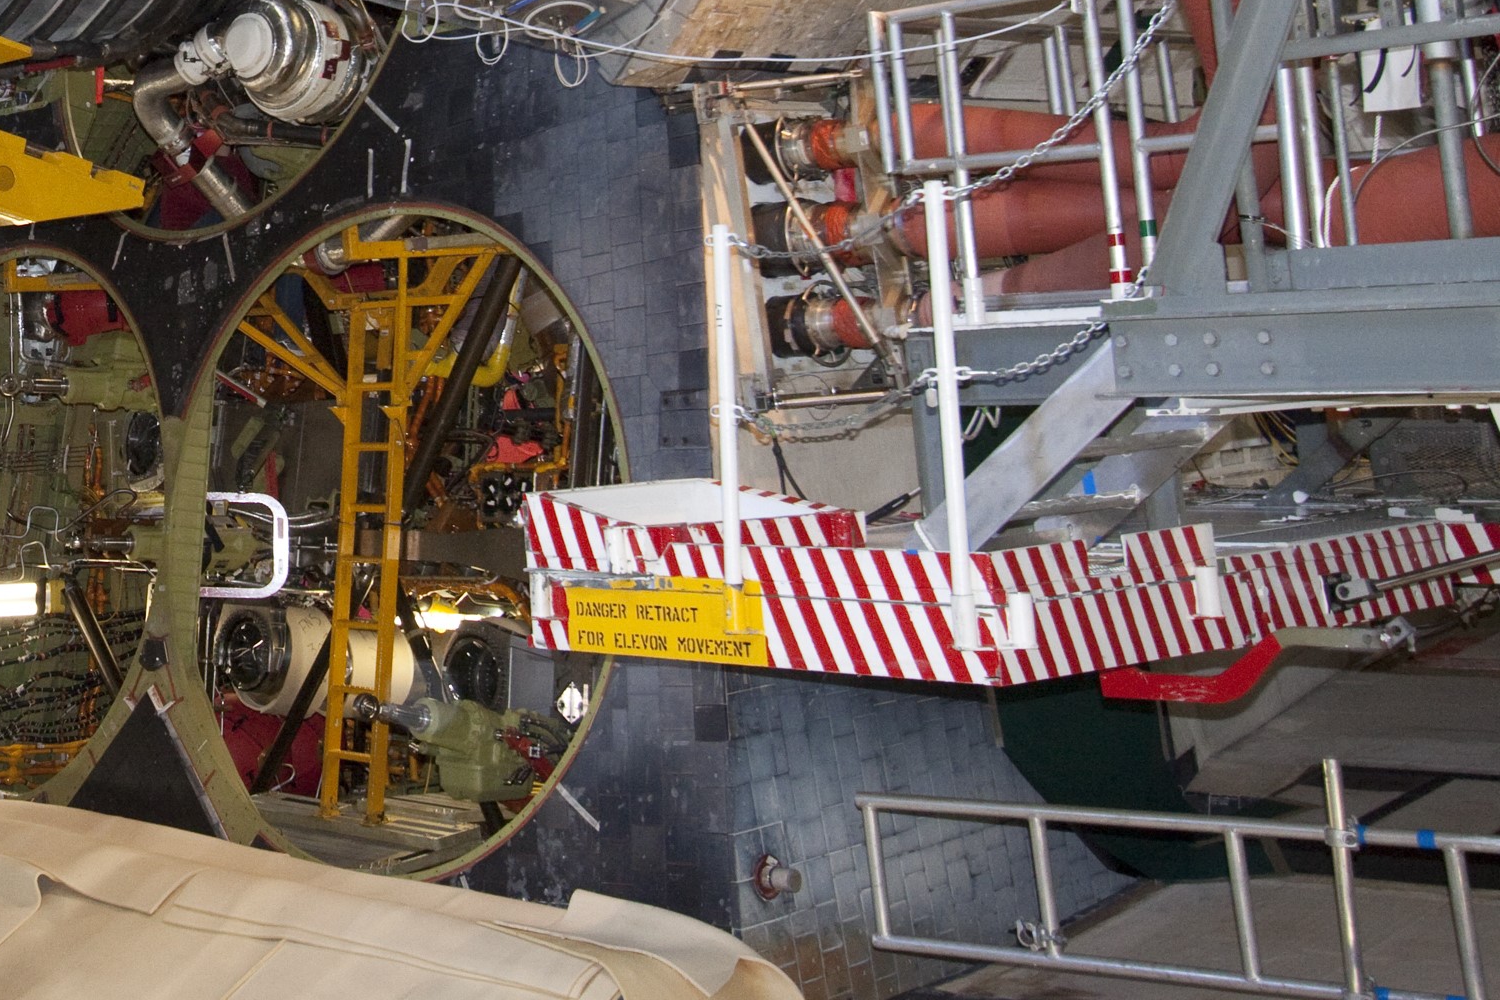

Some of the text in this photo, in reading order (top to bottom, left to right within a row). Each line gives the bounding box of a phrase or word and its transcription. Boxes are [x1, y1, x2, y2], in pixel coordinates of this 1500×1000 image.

[575, 601, 699, 623] DANGER RETRACT
[577, 629, 752, 658] FOR ELEVON MOVEMENT
